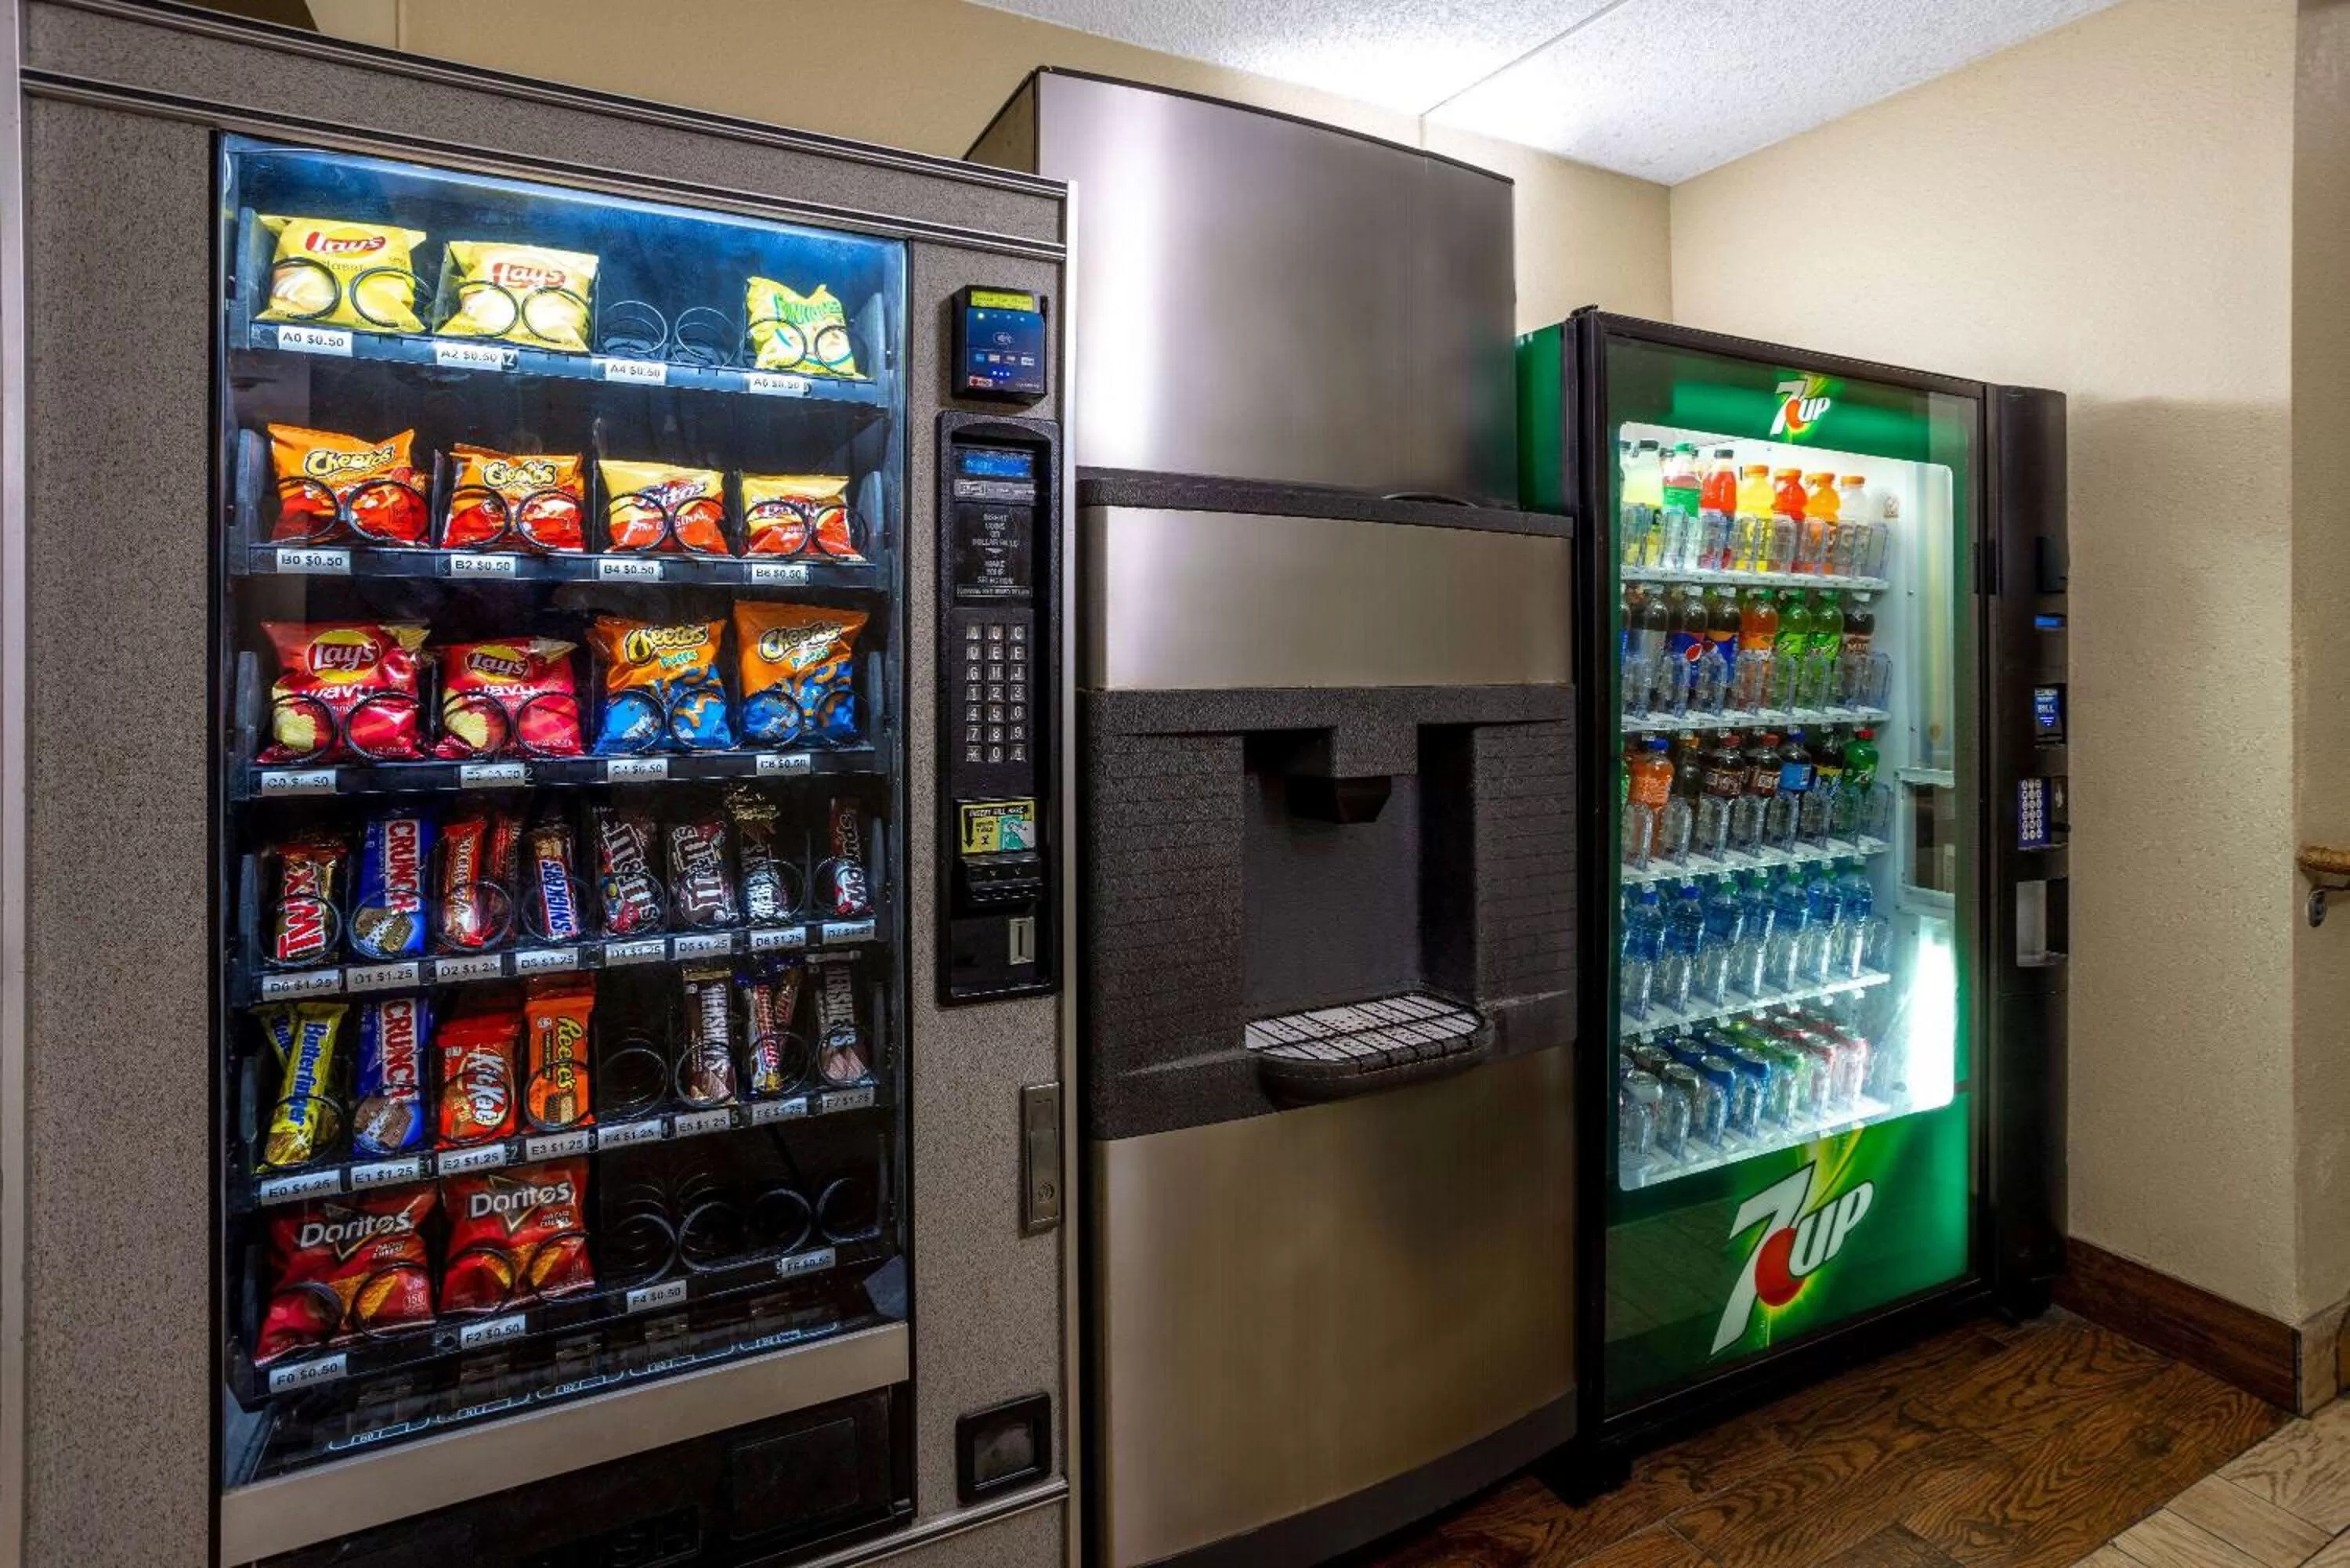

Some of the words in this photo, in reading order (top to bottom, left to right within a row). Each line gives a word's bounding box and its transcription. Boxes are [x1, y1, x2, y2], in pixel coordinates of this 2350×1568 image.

[283, 331, 302, 344] A0
[306, 334, 345, 348] $0.50
[441, 350, 459, 359] A2
[463, 351, 498, 363] $0.50
[281, 555, 300, 565] B0
[306, 555, 343, 566] $0.50
[455, 560, 472, 570] B2
[604, 565, 620, 574] B4
[992, 647, 1000, 658] E
[971, 667, 978, 677] G
[1014, 667, 1021, 677] J
[971, 688, 978, 698] 1
[992, 688, 1000, 698] 2
[1014, 688, 1021, 698] 3
[971, 708, 978, 718] 4
[992, 708, 1000, 718] 5
[971, 728, 978, 739] 7
[992, 728, 1000, 739] 8
[1014, 728, 1021, 739] 9
[992, 746, 1000, 757] 0
[388, 821, 418, 914] CRUNCH
[541, 860, 574, 933] SNICKERS
[354, 974, 371, 985] D1
[377, 969, 413, 982] $1.25
[441, 965, 458, 977] D2
[531, 1144, 548, 1155] E3
[551, 1139, 584, 1152] $1.25
[443, 1160, 460, 1170] E2
[464, 1153, 500, 1165] $1.25
[354, 1172, 371, 1183] E1
[377, 1166, 414, 1180] $1.25
[268, 1187, 288, 1198] E0
[292, 1180, 331, 1194] $1.25
[471, 1181, 571, 1219] Doritos
[300, 1212, 414, 1248] Doritos
[465, 1332, 483, 1345] F2
[486, 1324, 519, 1339] $0.50
[277, 1374, 295, 1386] F0
[299, 1362, 338, 1379] $0.50
